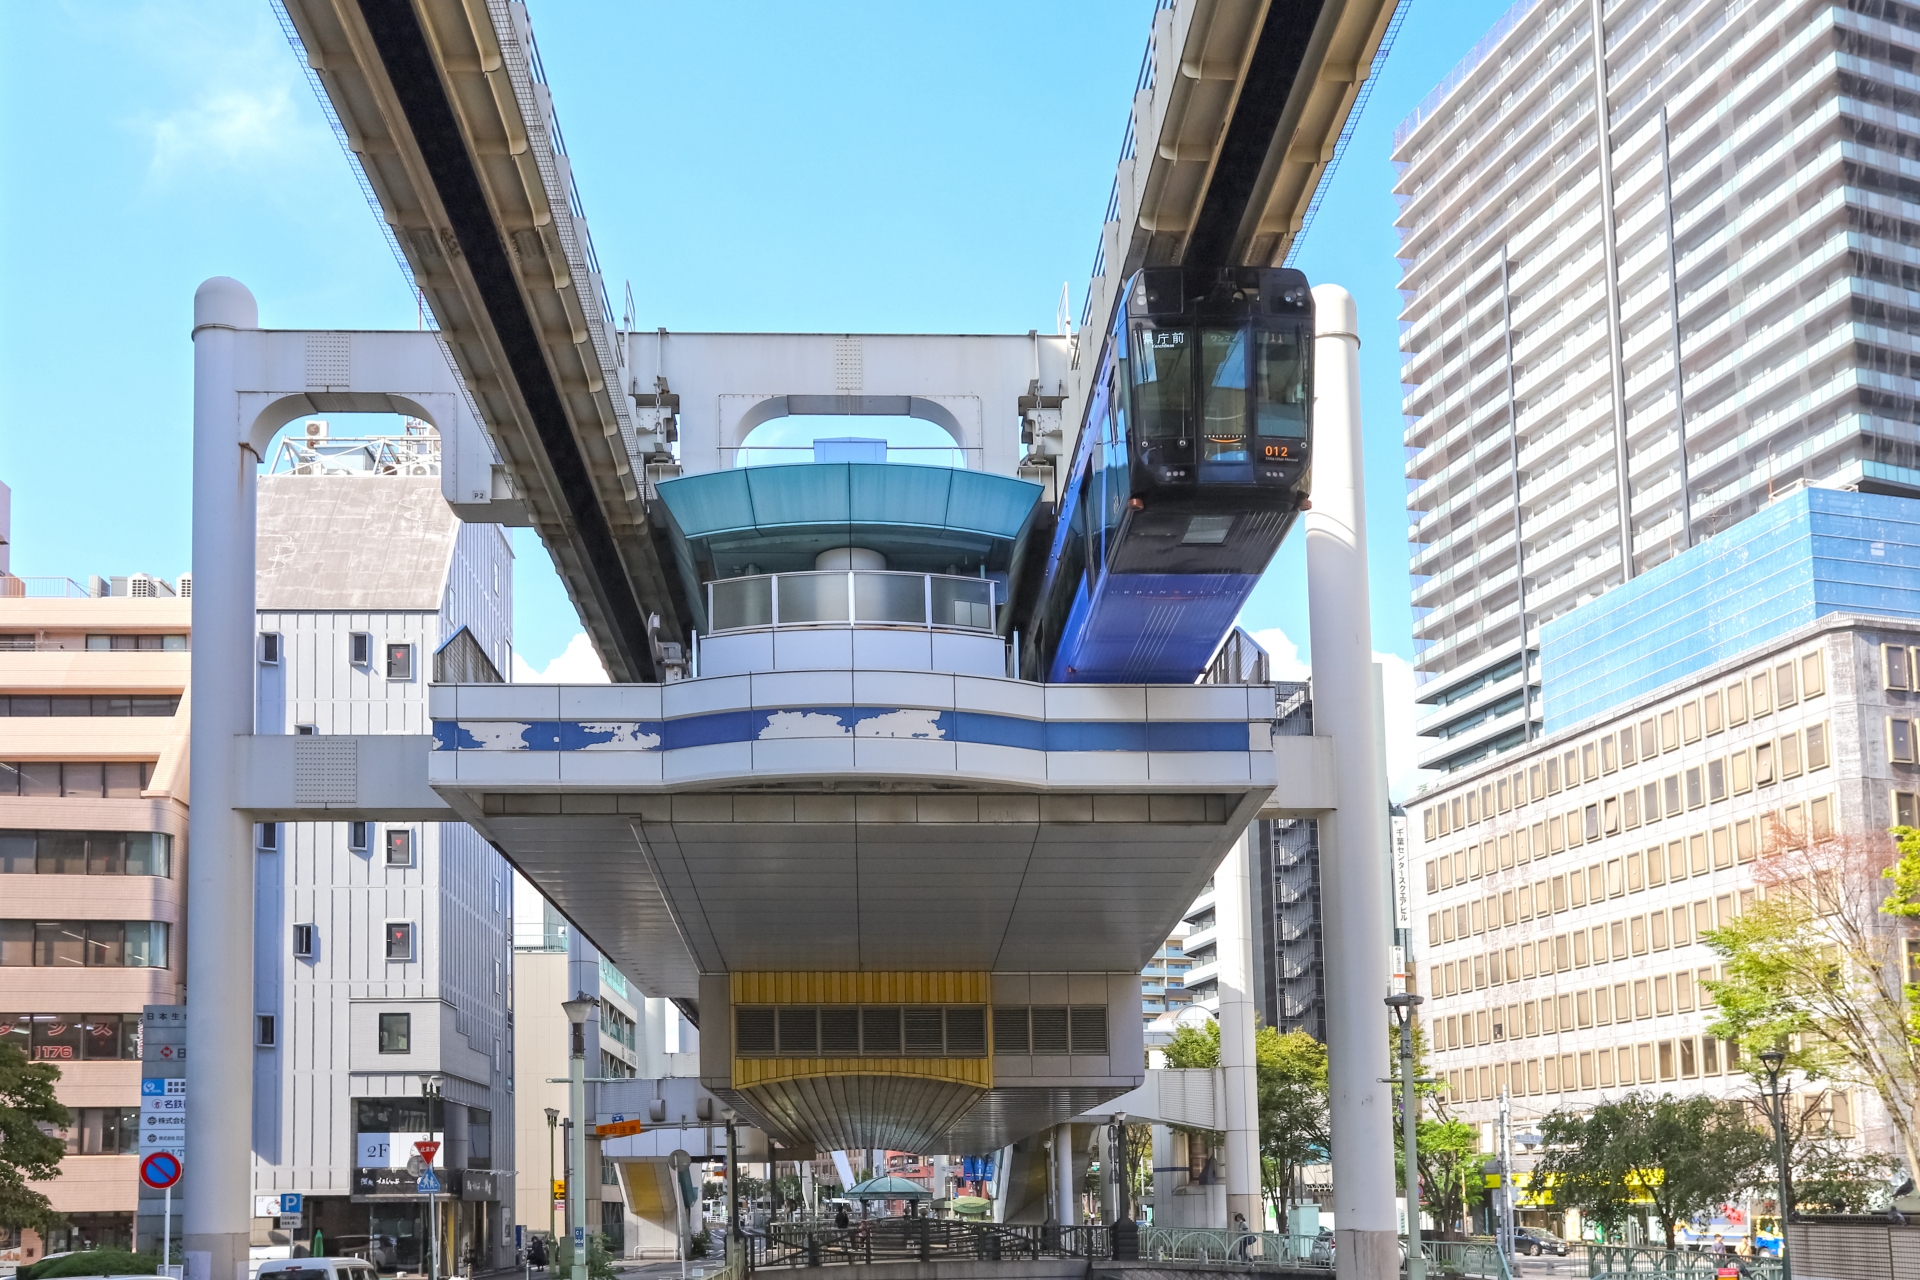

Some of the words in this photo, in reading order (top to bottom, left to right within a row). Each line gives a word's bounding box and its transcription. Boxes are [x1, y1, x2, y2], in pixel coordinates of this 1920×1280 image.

[1143, 332, 1185, 345] 県庁前
[1265, 445, 1288, 457] 012
[165, 1099, 186, 1109] 名鉄
[600, 1125, 637, 1134] 走行注意
[367, 1143, 390, 1158] 2F
[285, 1195, 297, 1211] P
